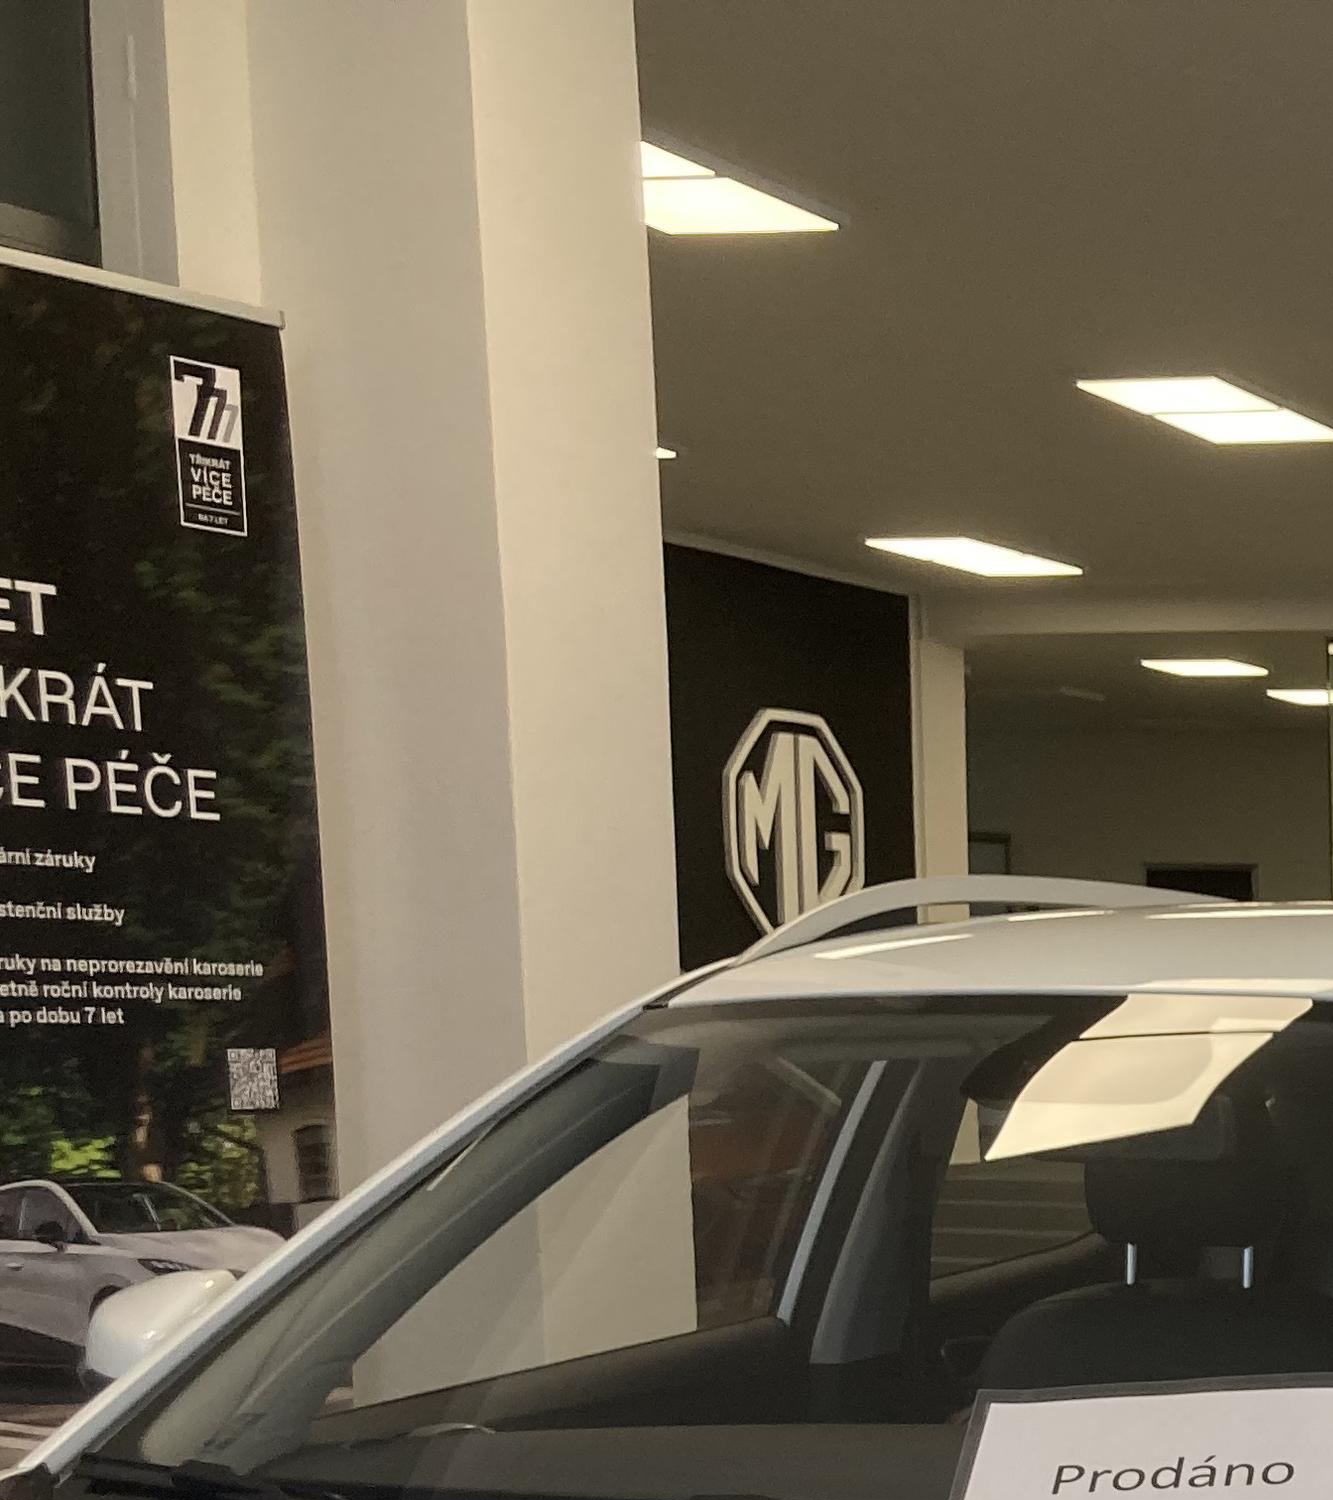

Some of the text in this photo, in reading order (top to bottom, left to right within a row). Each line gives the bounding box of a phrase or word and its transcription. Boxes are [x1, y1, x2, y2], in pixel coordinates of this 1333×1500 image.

[190, 467, 232, 488] VÍCE
[192, 484, 233, 506] PÉČE
[65, 750, 221, 822] PÉČE
[34, 849, 96, 873] záruky
[66, 903, 126, 927] služby
[41, 959, 62, 972] na
[66, 957, 190, 977] neprorezavění
[193, 958, 263, 977] karoserie
[43, 980, 88, 998] roční
[93, 982, 164, 1004] kontroly
[168, 983, 242, 1001] karoserie
[9, 1009, 33, 1028] po
[36, 1006, 81, 1024] dobu
[84, 1006, 96, 1024] 7
[100, 1007, 125, 1025] let
[1051, 1454, 1295, 1495] Prodáno
